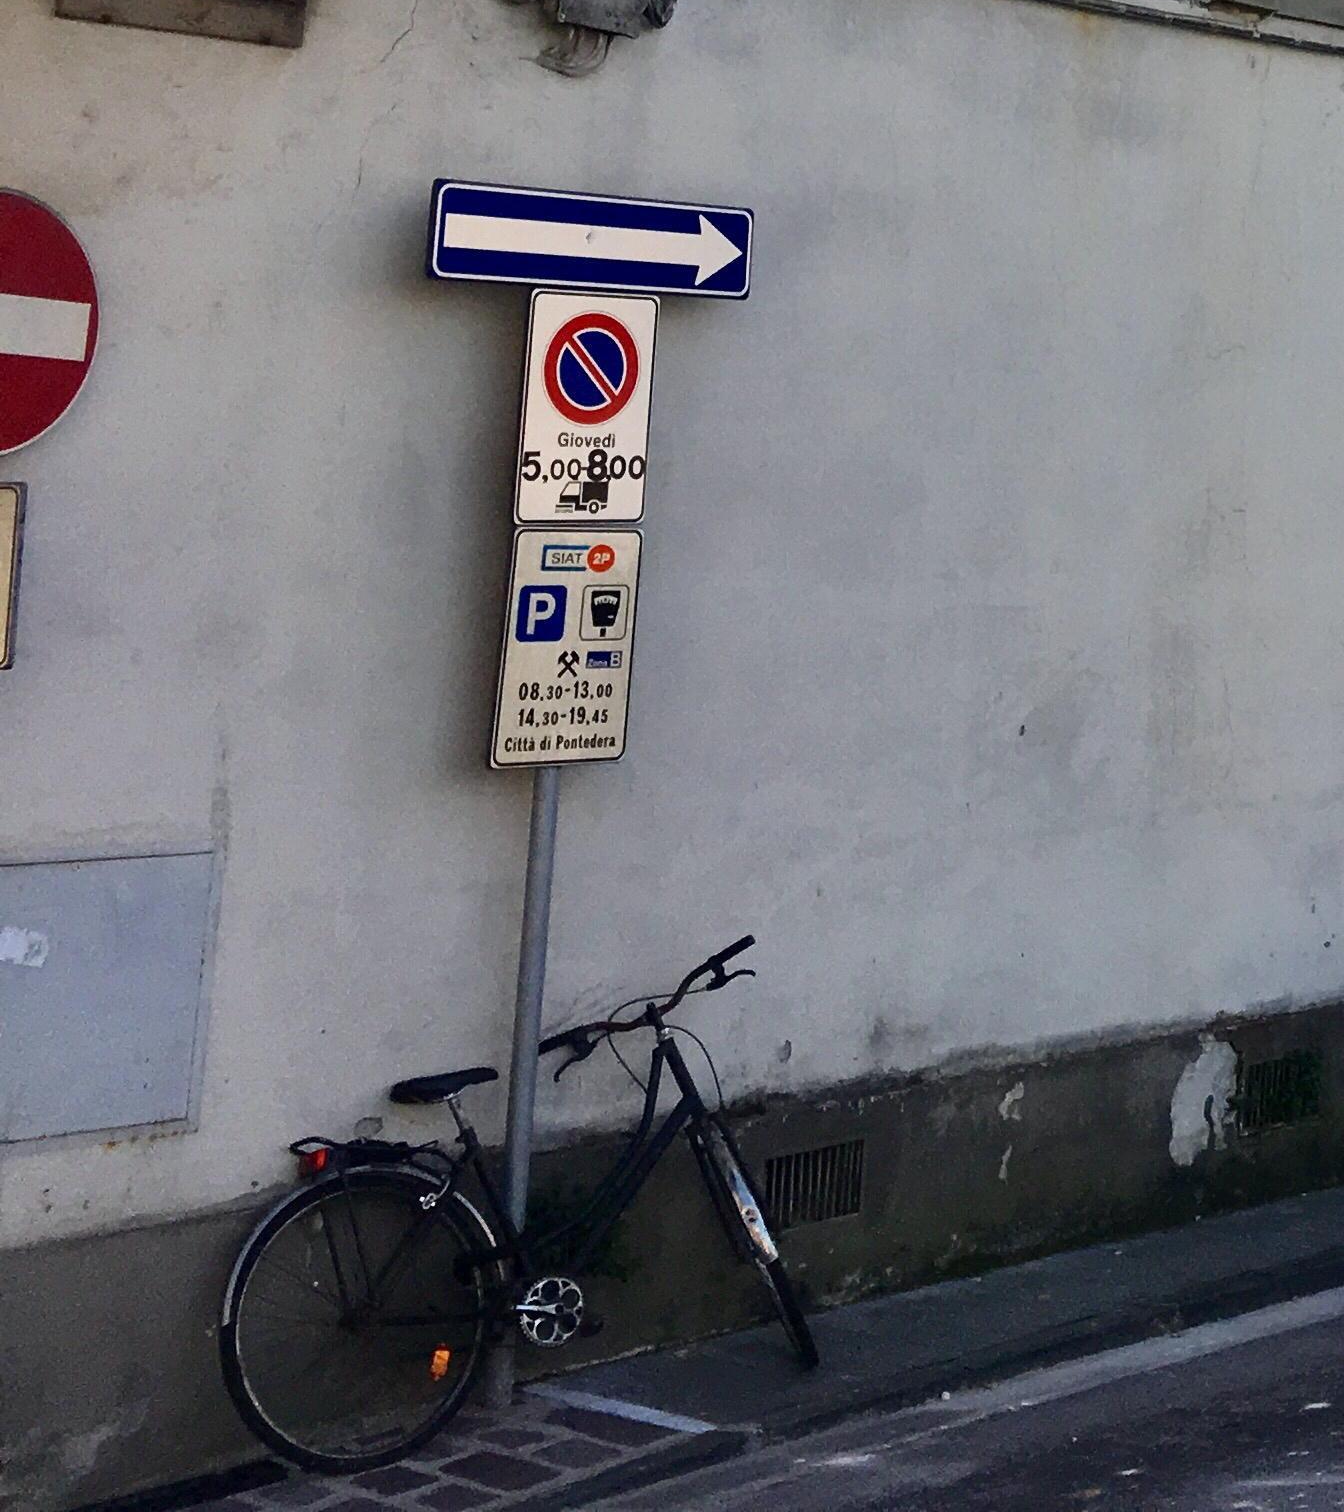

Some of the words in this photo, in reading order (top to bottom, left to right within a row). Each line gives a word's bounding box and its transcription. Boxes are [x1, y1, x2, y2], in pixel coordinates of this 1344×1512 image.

[557, 432, 616, 448] Giovedì
[551, 552, 583, 565] SIAT
[592, 552, 611, 565] 2P
[526, 592, 556, 636] P
[610, 652, 621, 667] B
[504, 737, 536, 753] Città
[540, 735, 552, 751] di
[556, 733, 616, 750] Pontedera
